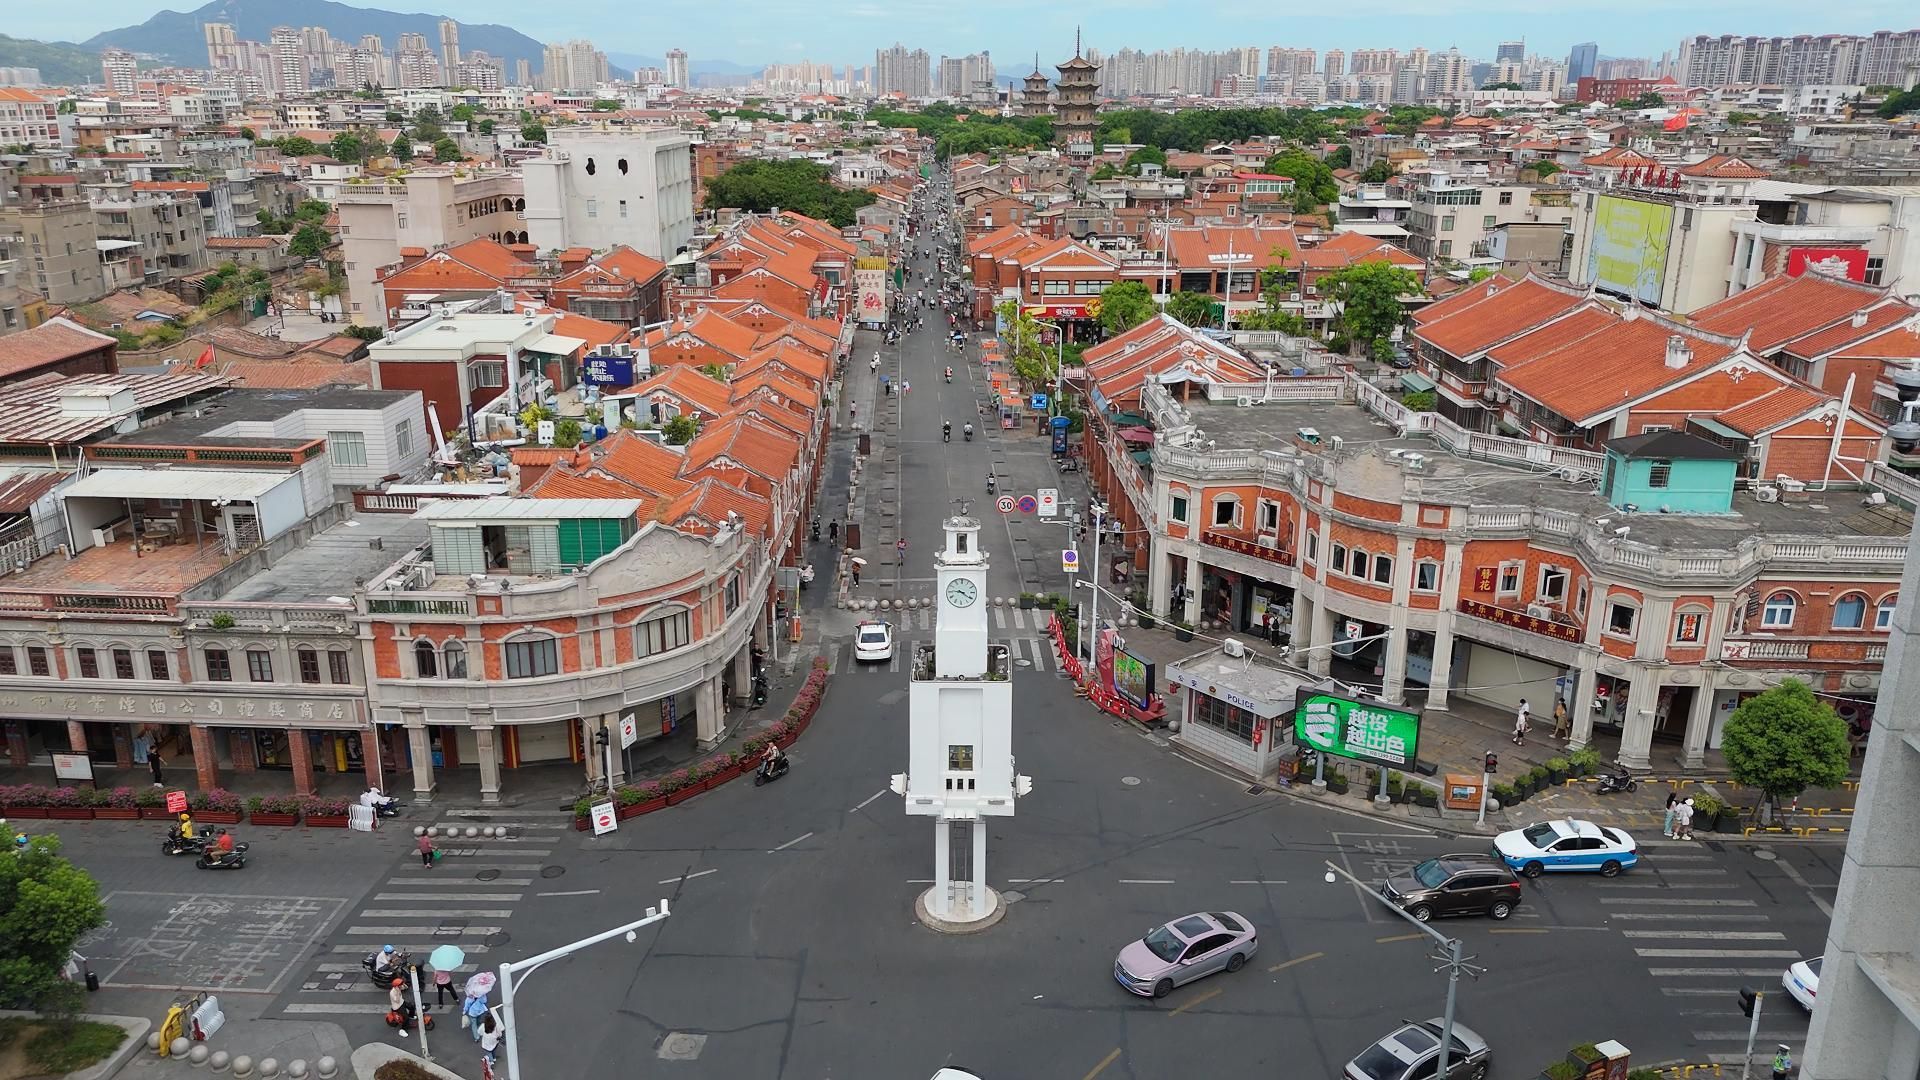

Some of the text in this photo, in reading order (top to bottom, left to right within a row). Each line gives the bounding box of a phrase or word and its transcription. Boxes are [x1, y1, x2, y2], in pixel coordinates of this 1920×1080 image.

[1000, 501, 1012, 510] 30
[1227, 693, 1255, 711] POLICE
[1348, 709, 1388, 733] 越投
[1346, 725, 1405, 757] 越出色
